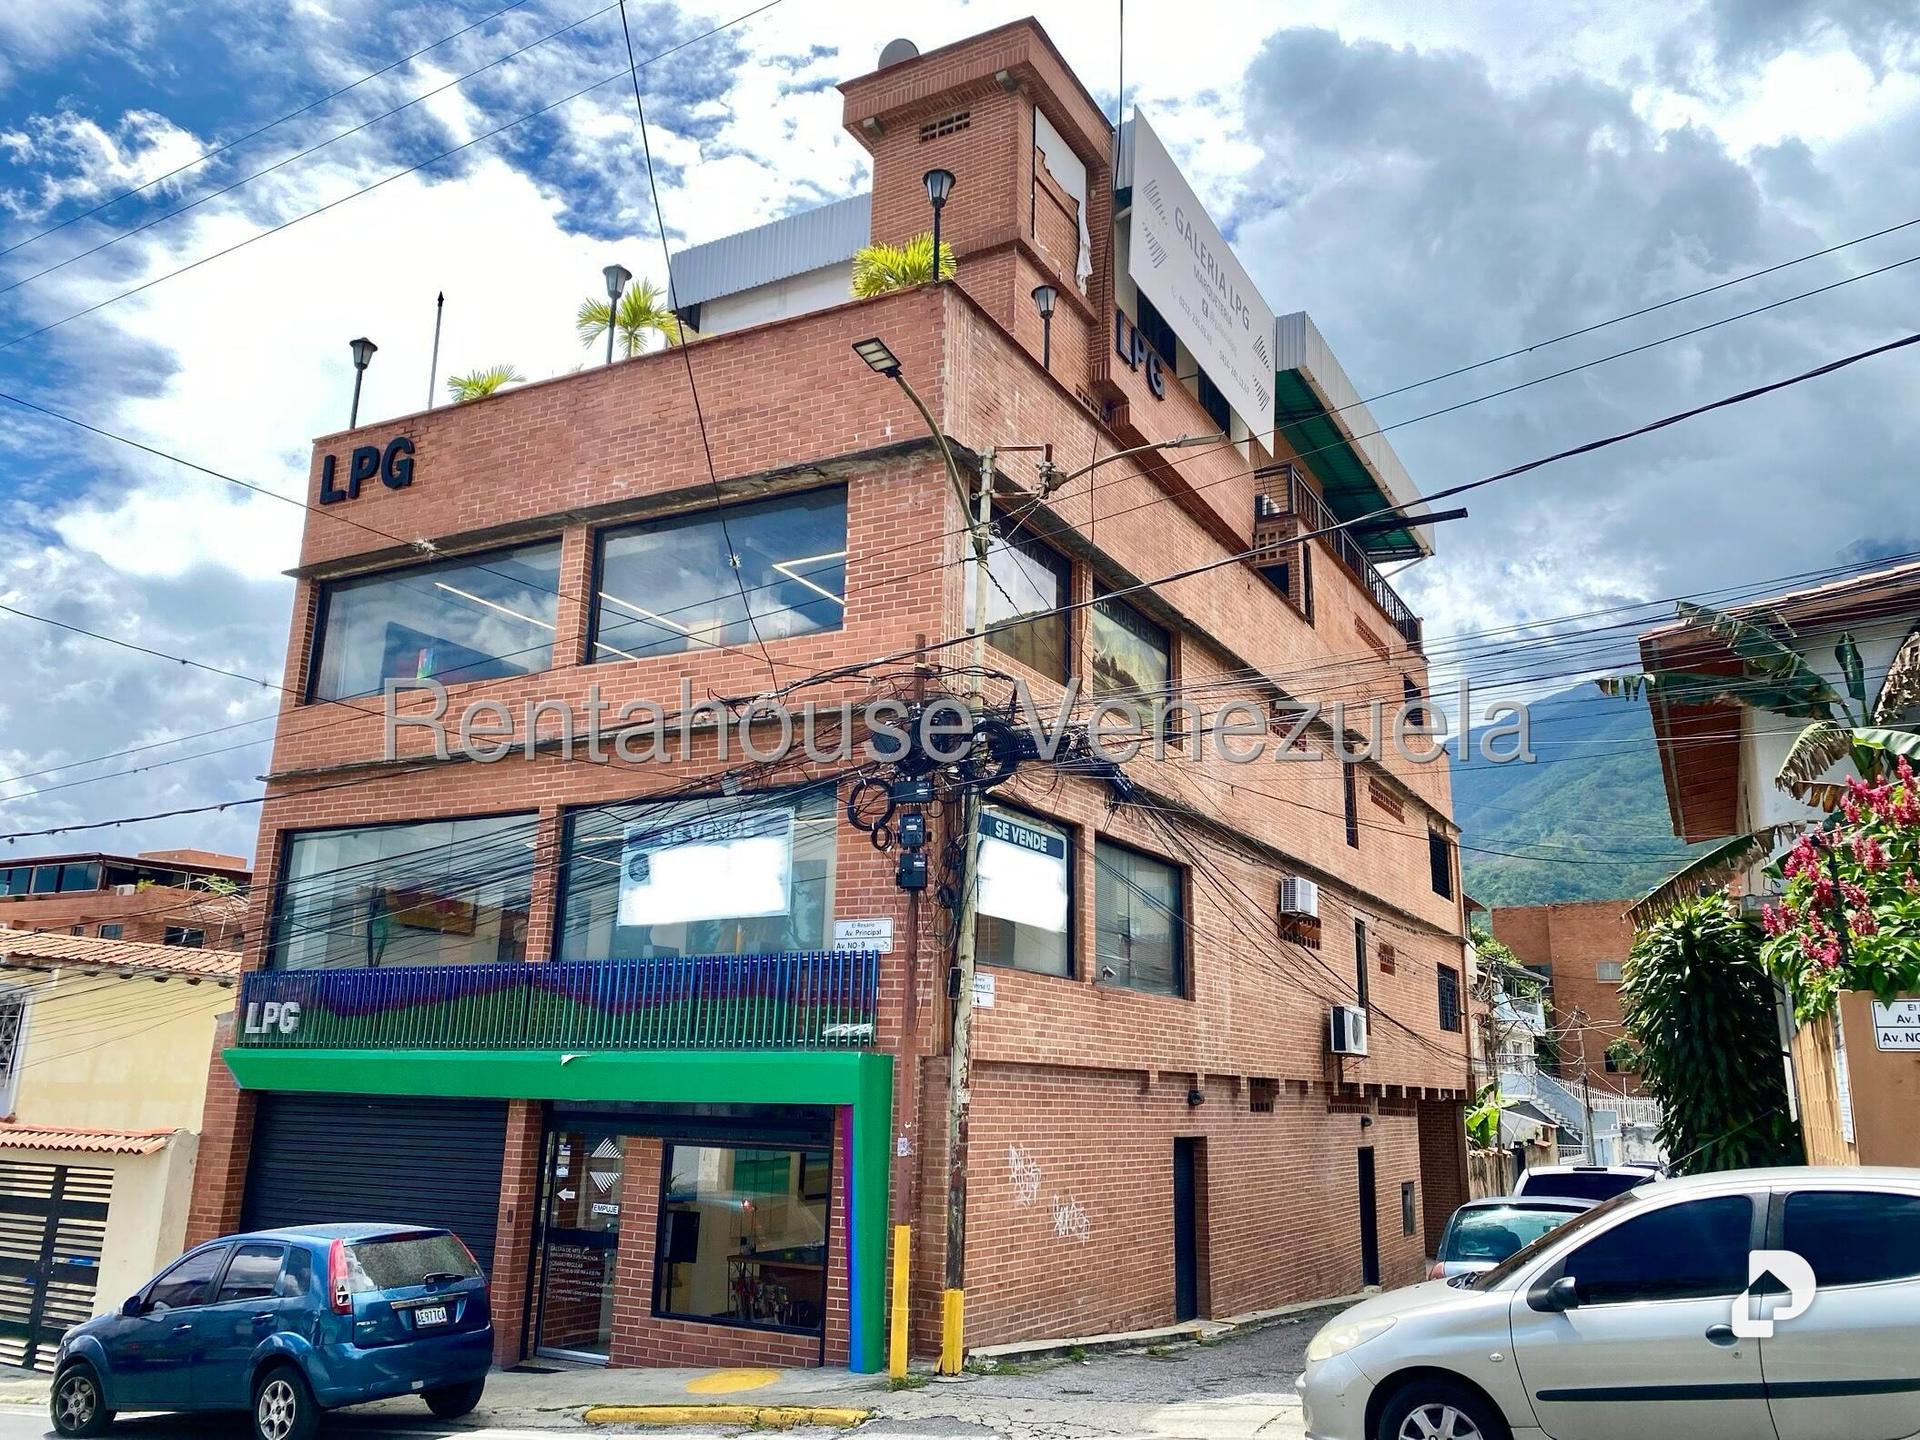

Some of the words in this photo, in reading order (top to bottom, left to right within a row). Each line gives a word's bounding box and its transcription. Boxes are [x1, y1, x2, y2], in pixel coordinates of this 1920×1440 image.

[1174, 206, 1227, 299] GALERIA
[1229, 284, 1250, 332] LPG
[1193, 264, 1233, 329] MARQUETERIA
[1116, 308, 1166, 401] LPG
[319, 436, 416, 505] LPG
[995, 820, 1010, 840] SE
[1011, 826, 1048, 852] VENDE
[244, 1001, 301, 1034] LPG
[1896, 1014, 1915, 1024] Av.
[1907, 1003, 1917, 1012] El
[1882, 1032, 1903, 1043] Av.
[593, 1203, 618, 1214] EMPUJE
